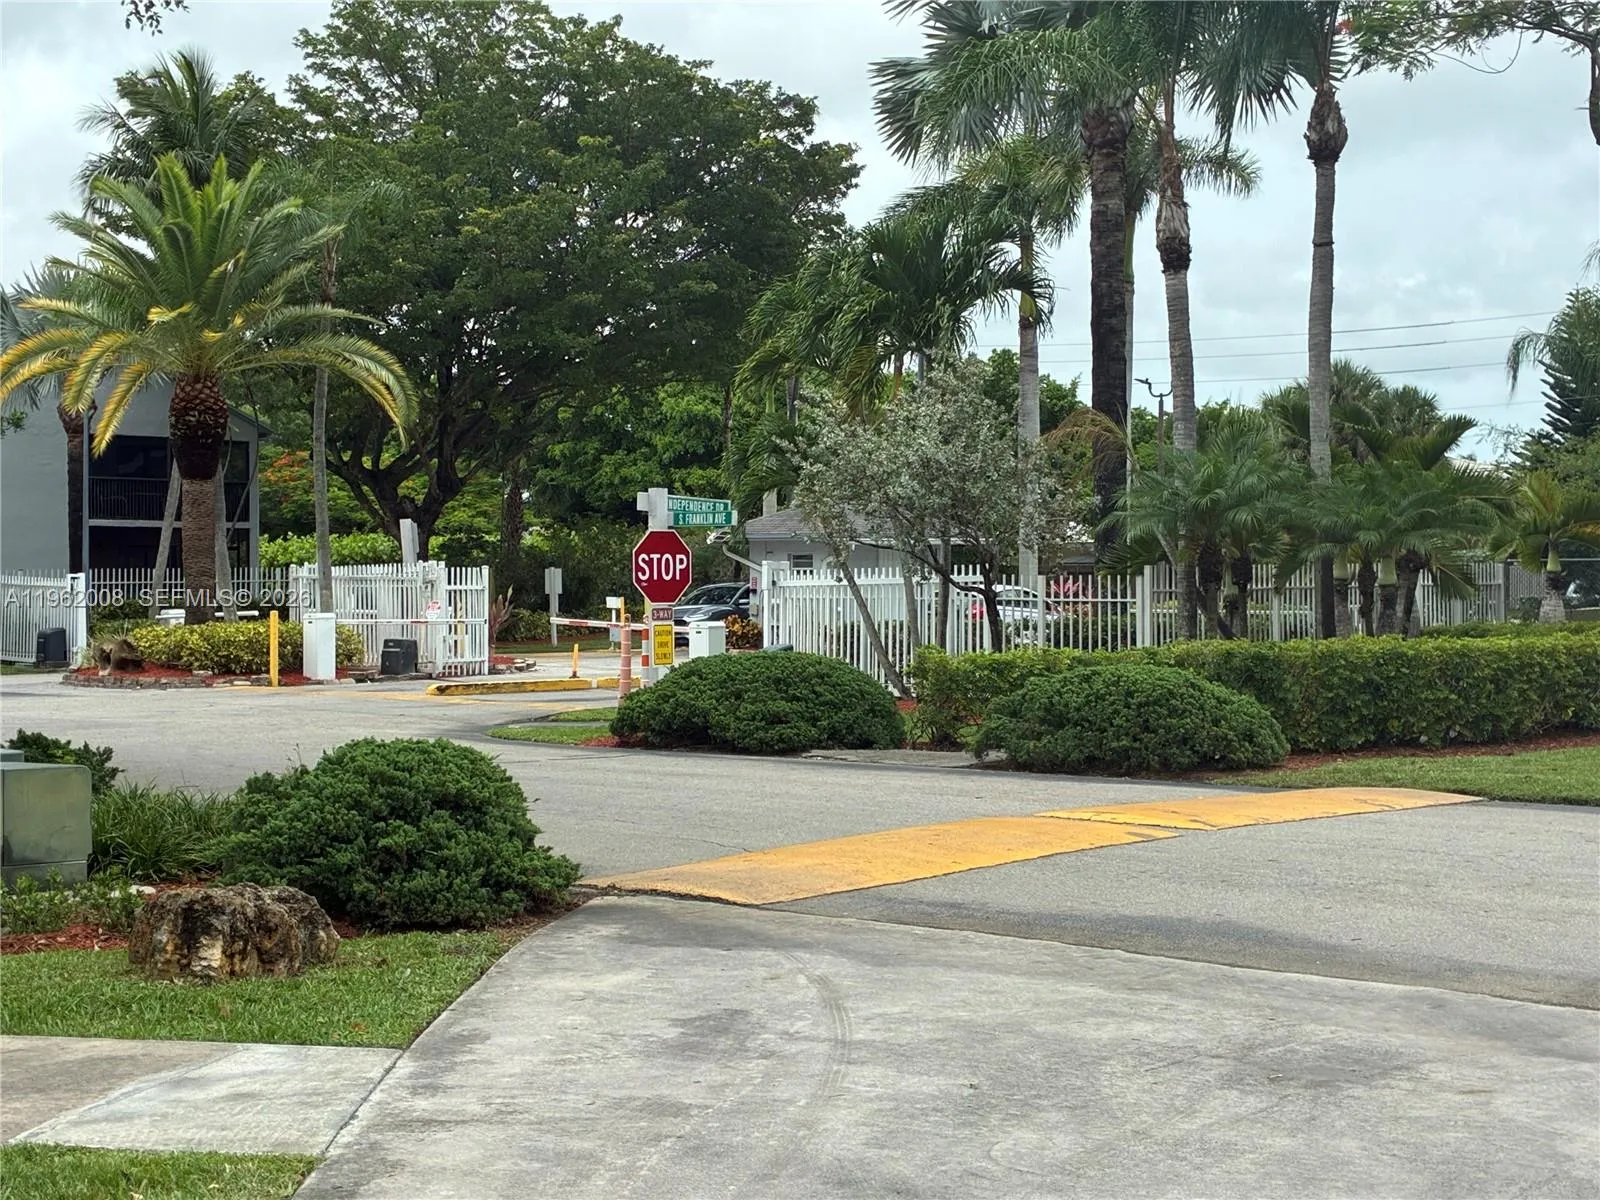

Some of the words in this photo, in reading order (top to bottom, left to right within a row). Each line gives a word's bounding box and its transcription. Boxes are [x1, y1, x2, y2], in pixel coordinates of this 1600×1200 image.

[668, 498, 714, 512] NDEPENDENCE
[685, 513, 713, 525] FRANKLIN
[714, 513, 726, 525] AVE
[637, 553, 688, 581] STOP
[652, 610, 672, 619] 3-WAY
